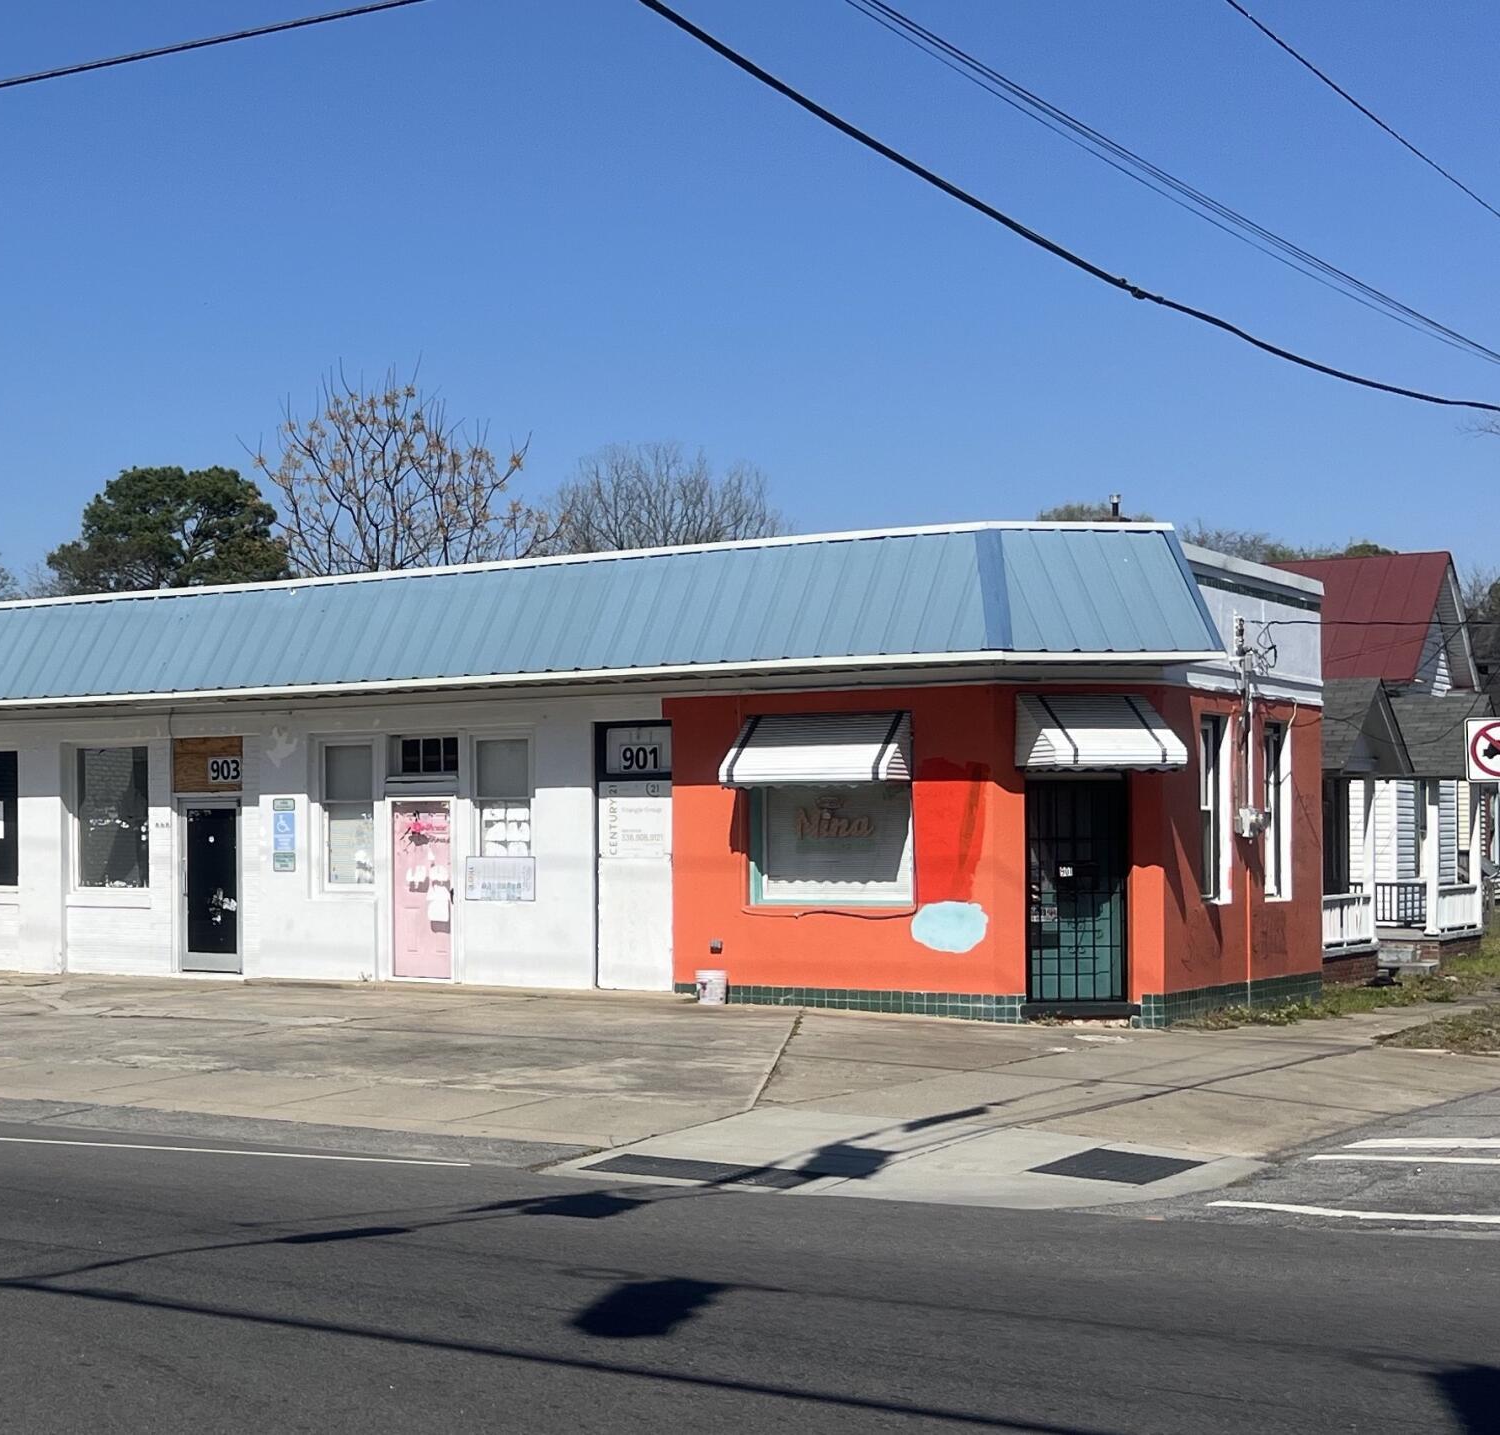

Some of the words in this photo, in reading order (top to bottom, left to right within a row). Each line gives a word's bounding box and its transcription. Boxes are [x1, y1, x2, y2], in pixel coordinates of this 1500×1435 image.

[622, 746, 659, 770] 901
[211, 759, 241, 780] 903
[609, 784, 618, 794] 21
[650, 783, 660, 793] 21
[609, 797, 618, 856] CENTURY
[795, 807, 876, 840] Nina
